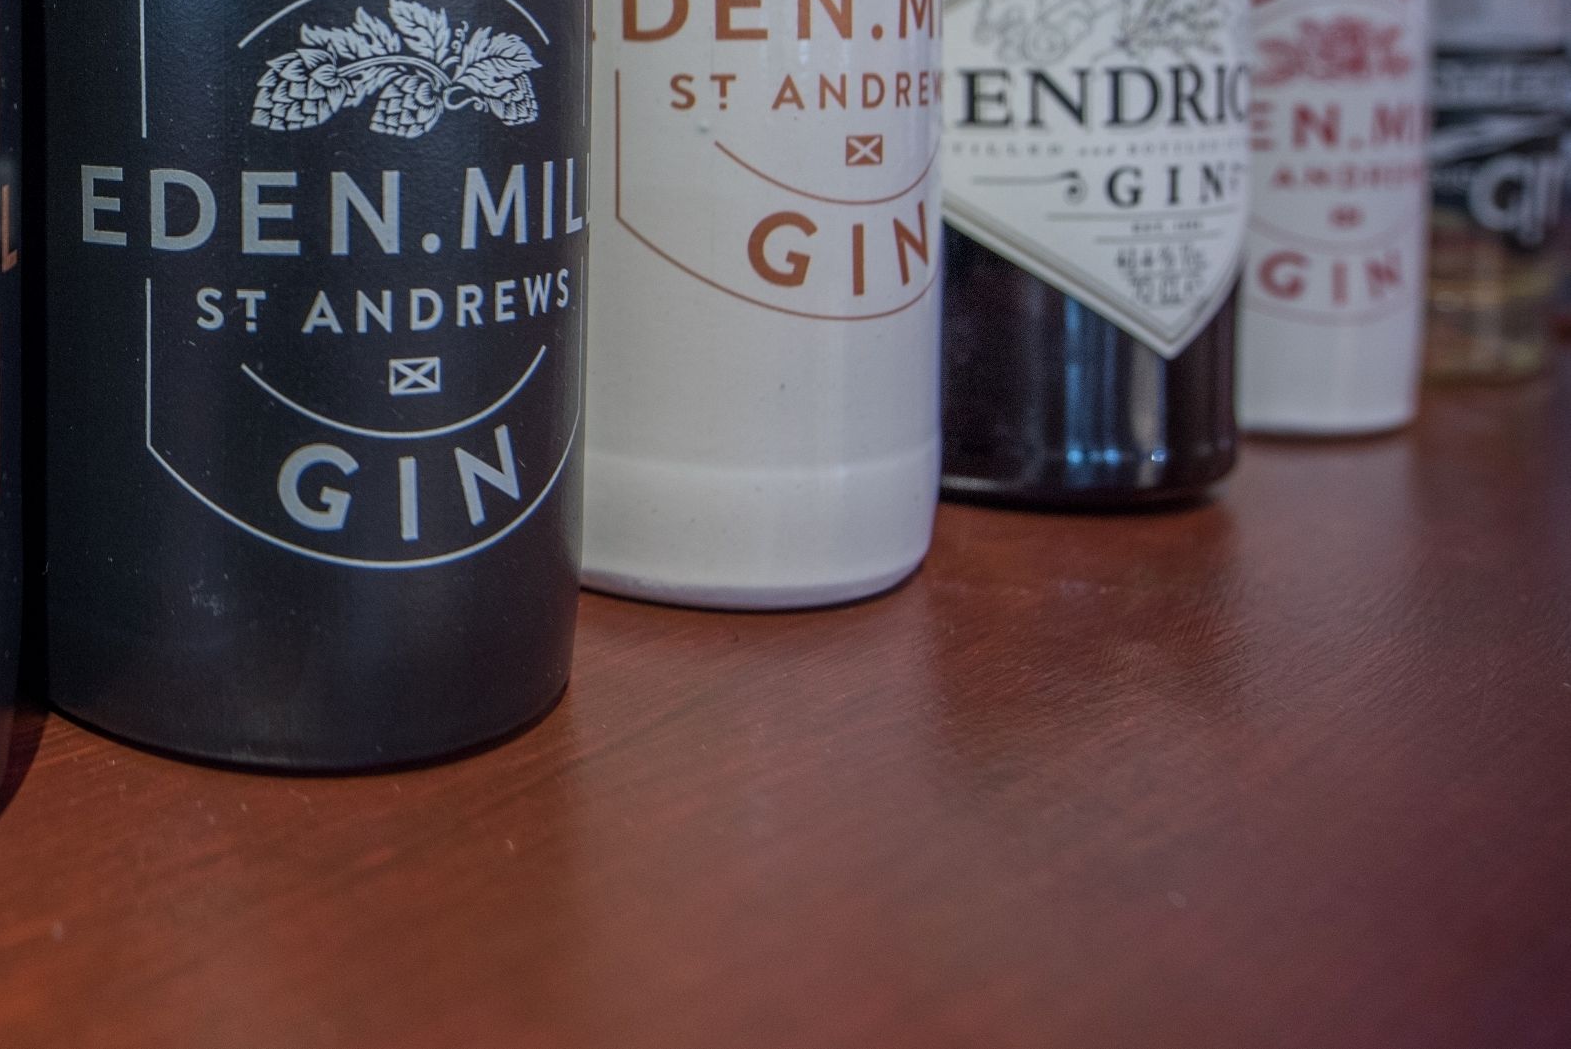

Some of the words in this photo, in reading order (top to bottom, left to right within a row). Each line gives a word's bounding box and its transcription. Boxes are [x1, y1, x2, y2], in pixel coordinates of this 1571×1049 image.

[1106, 160, 1244, 210] GIN
[747, 199, 929, 297] GIN
[1257, 249, 1403, 306] GIN
[302, 267, 570, 335] ANDREWS
[276, 423, 521, 542] GIN
